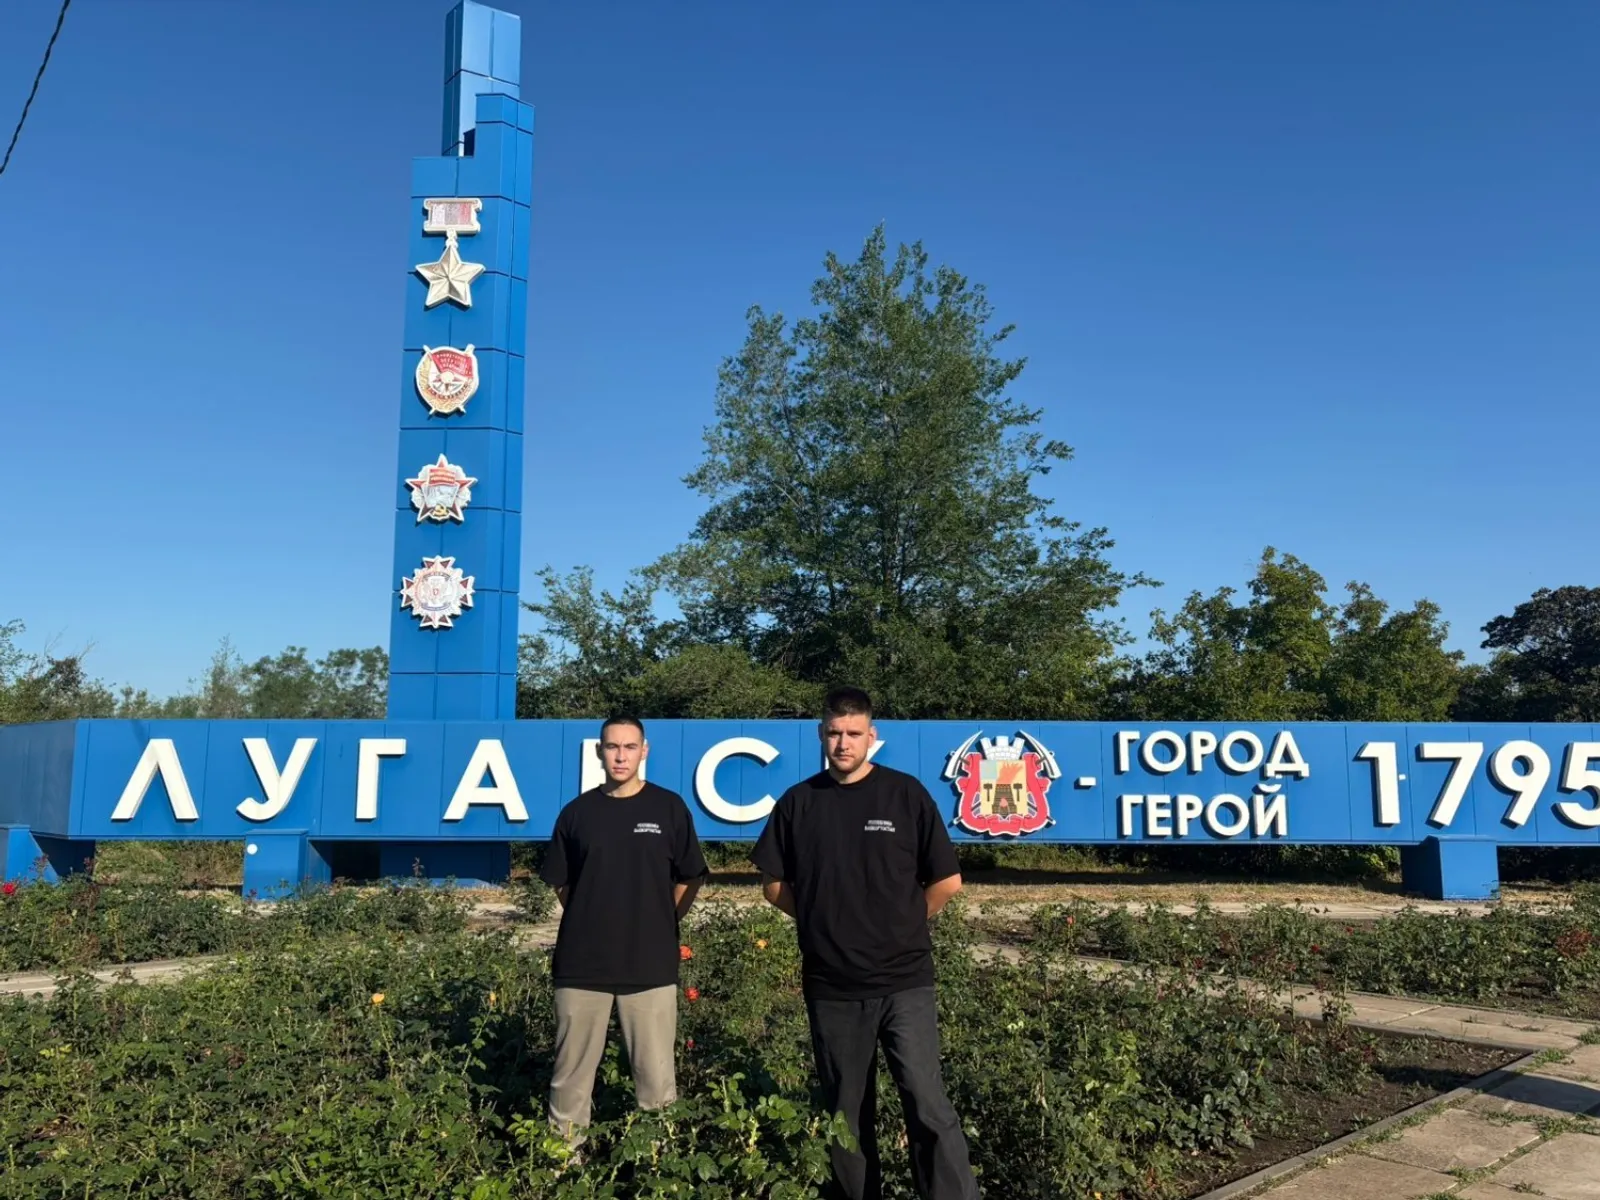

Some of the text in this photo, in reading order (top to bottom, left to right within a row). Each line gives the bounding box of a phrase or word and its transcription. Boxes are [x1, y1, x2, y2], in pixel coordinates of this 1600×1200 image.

[110, 736, 887, 822] ЛУГАС
[1118, 730, 1310, 780] ГОРОД
[1355, 738, 1600, 827] 1795
[1121, 782, 1289, 838] ГЕРОЙ
